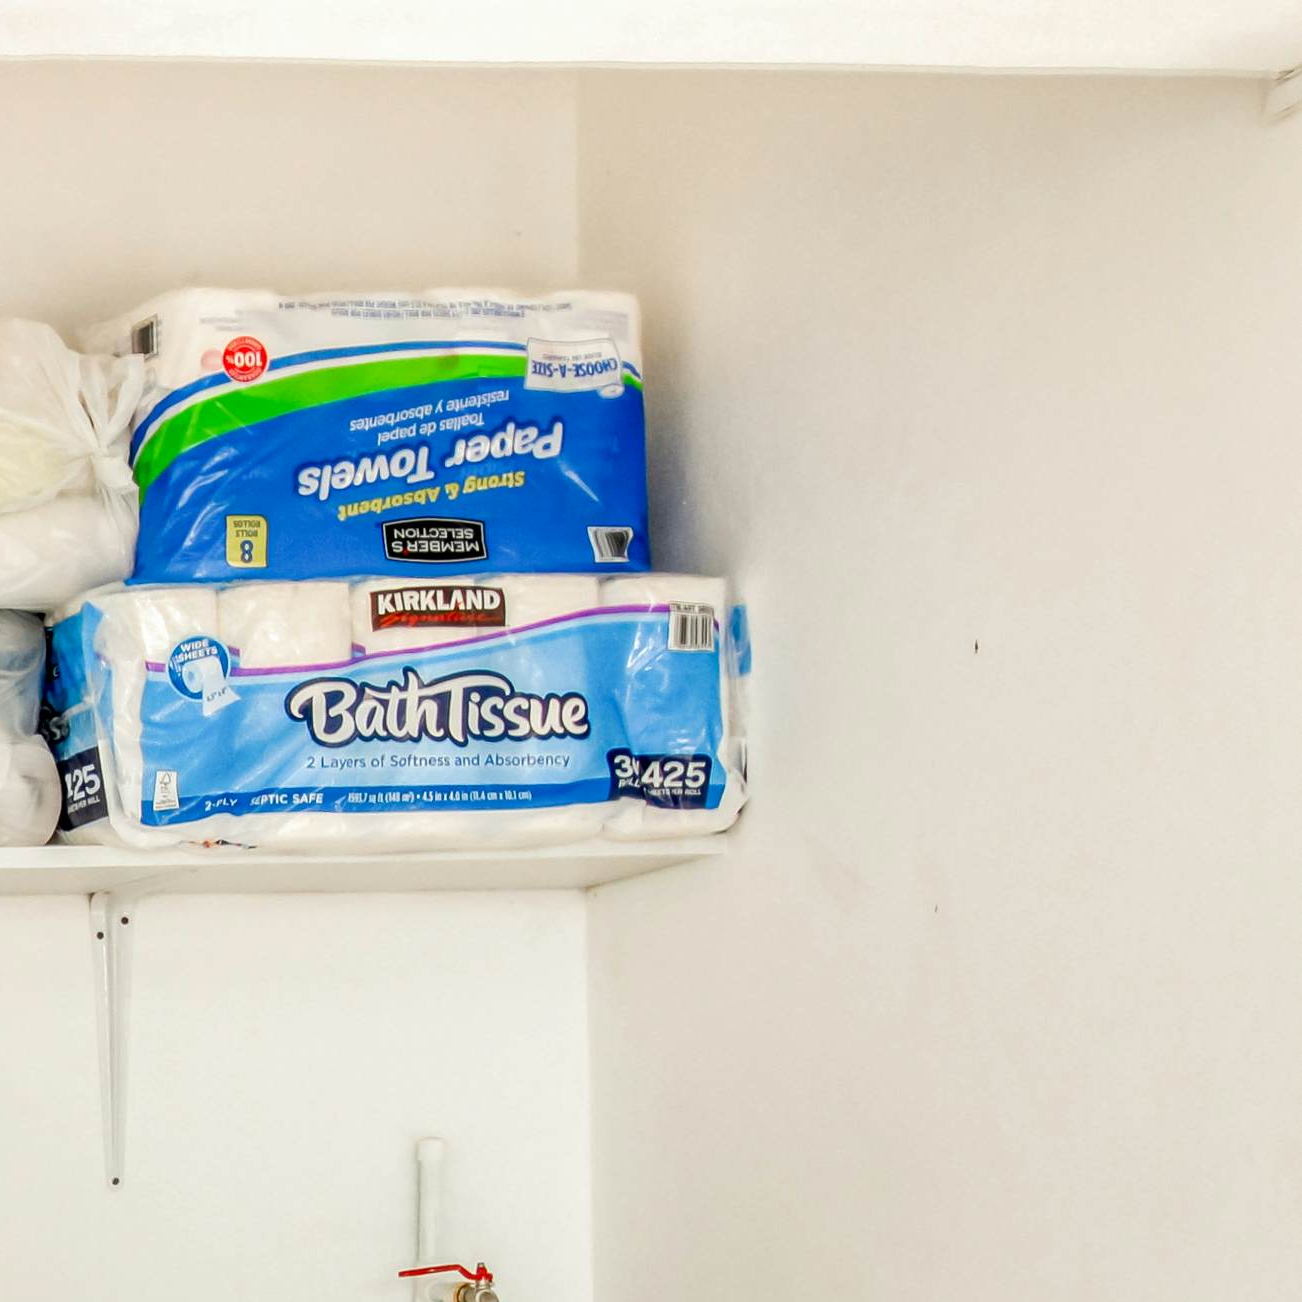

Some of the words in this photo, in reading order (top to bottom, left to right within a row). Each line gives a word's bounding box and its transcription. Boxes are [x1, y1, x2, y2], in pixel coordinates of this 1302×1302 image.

[531, 358, 618, 378] CHOOSE-A-SIZE
[435, 399, 444, 414] y
[446, 389, 509, 413] resistente
[349, 404, 433, 433] absorbentes
[419, 421, 437, 437] de
[439, 412, 485, 433] Toallas
[378, 422, 417, 446] papel
[444, 421, 564, 470] Paper
[297, 445, 435, 500] Towels
[444, 482, 459, 500] &
[463, 470, 525, 498] Strong
[338, 485, 440, 521] Absorbent
[393, 526, 474, 541] SELECTION
[240, 540, 254, 563] 8
[391, 538, 479, 555] MEMBER'S
[378, 589, 501, 615] KIRKLAND
[177, 646, 218, 662] SHEETS
[181, 639, 209, 651] WIDE
[289, 669, 446, 745] Bath
[429, 674, 589, 743] Tissue
[307, 757, 316, 769] 2
[320, 756, 365, 773] Layers
[370, 755, 386, 769] of
[390, 755, 448, 770] Softness
[453, 754, 480, 768] and
[484, 753, 571, 772] Absorbency
[640, 760, 707, 788] 425
[292, 793, 324, 804] SAFE
